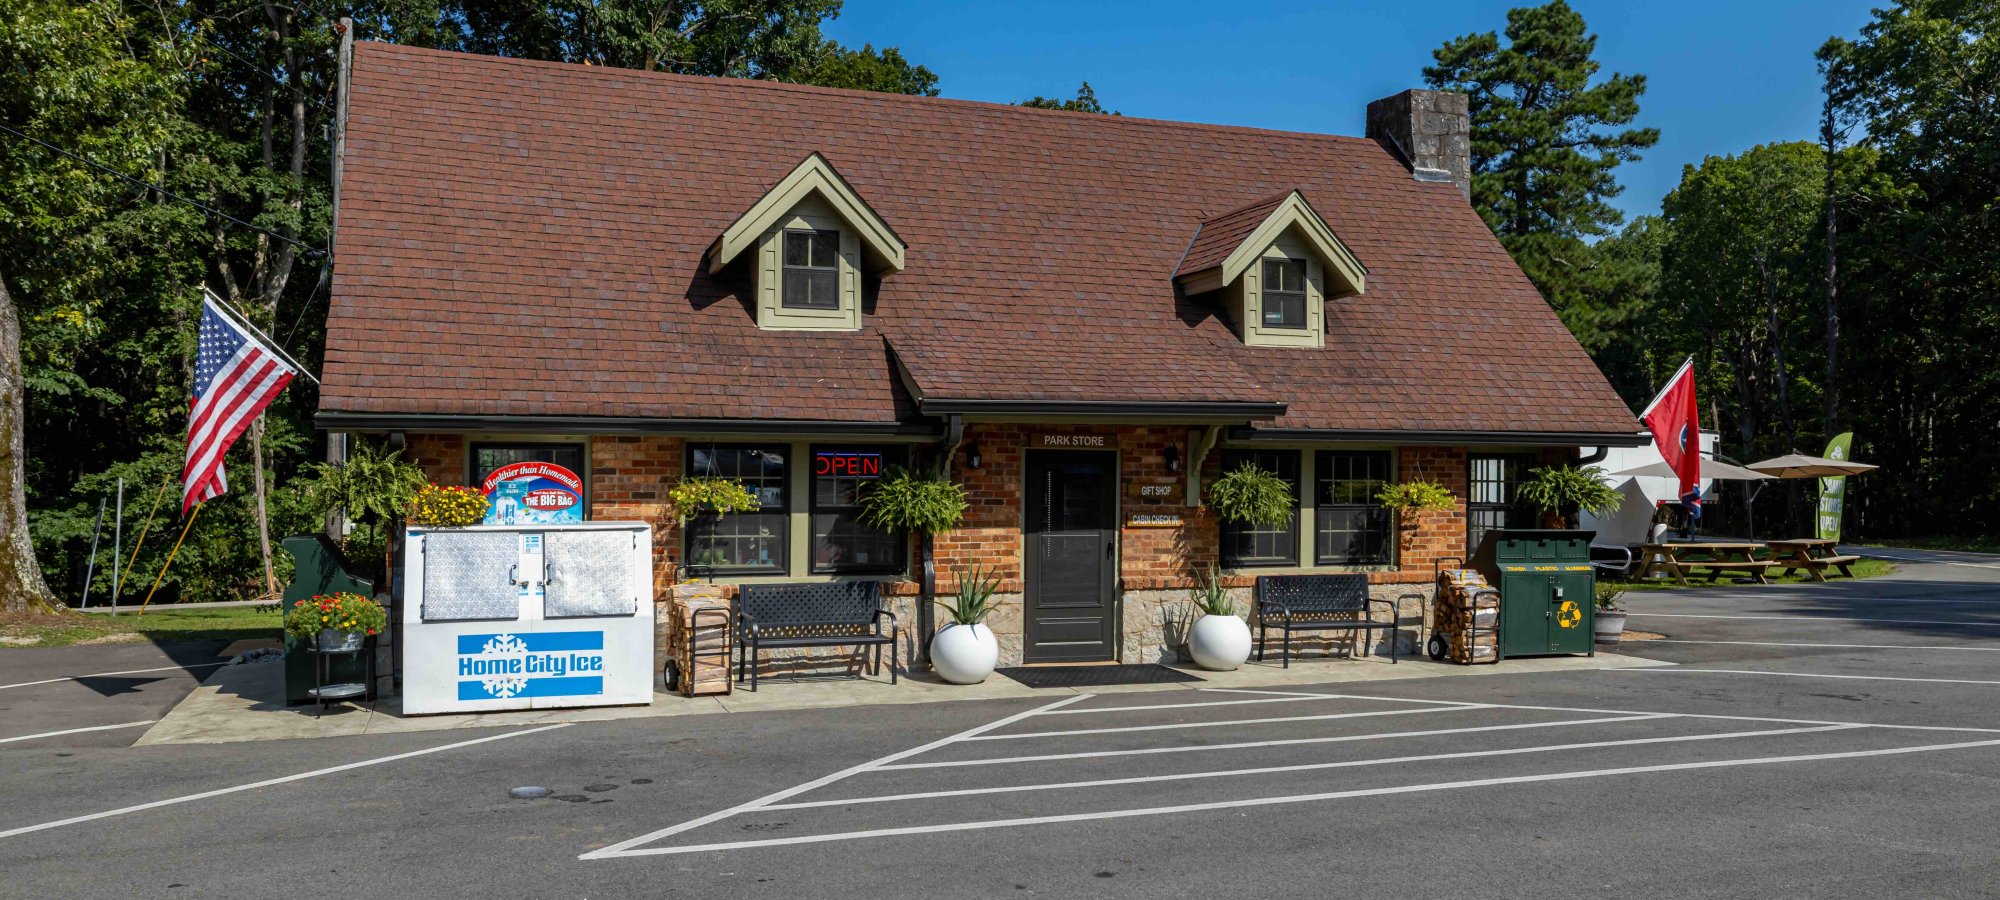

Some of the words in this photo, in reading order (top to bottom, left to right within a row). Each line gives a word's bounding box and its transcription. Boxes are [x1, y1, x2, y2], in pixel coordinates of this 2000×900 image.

[1044, 435, 1070, 446] PARK
[1072, 435, 1104, 446] STORE
[816, 456, 879, 475] OPEN
[485, 469, 519, 490] Healthier
[520, 465, 537, 475] than
[538, 465, 579, 489] Homemade
[1141, 486, 1154, 496] GIFT
[1155, 486, 1172, 496] SHOP
[525, 496, 539, 506] THE
[540, 494, 556, 506] BIG
[557, 495, 573, 506] BAG
[1820, 497, 1841, 512] STORE
[1132, 514, 1150, 525] CABIN
[1151, 514, 1171, 525] CHECK
[1172, 514, 1179, 524] IN
[1820, 516, 1838, 531] OPEN
[458, 657, 522, 676] Home
[525, 654, 567, 676] City
[569, 653, 603, 672] Ice
